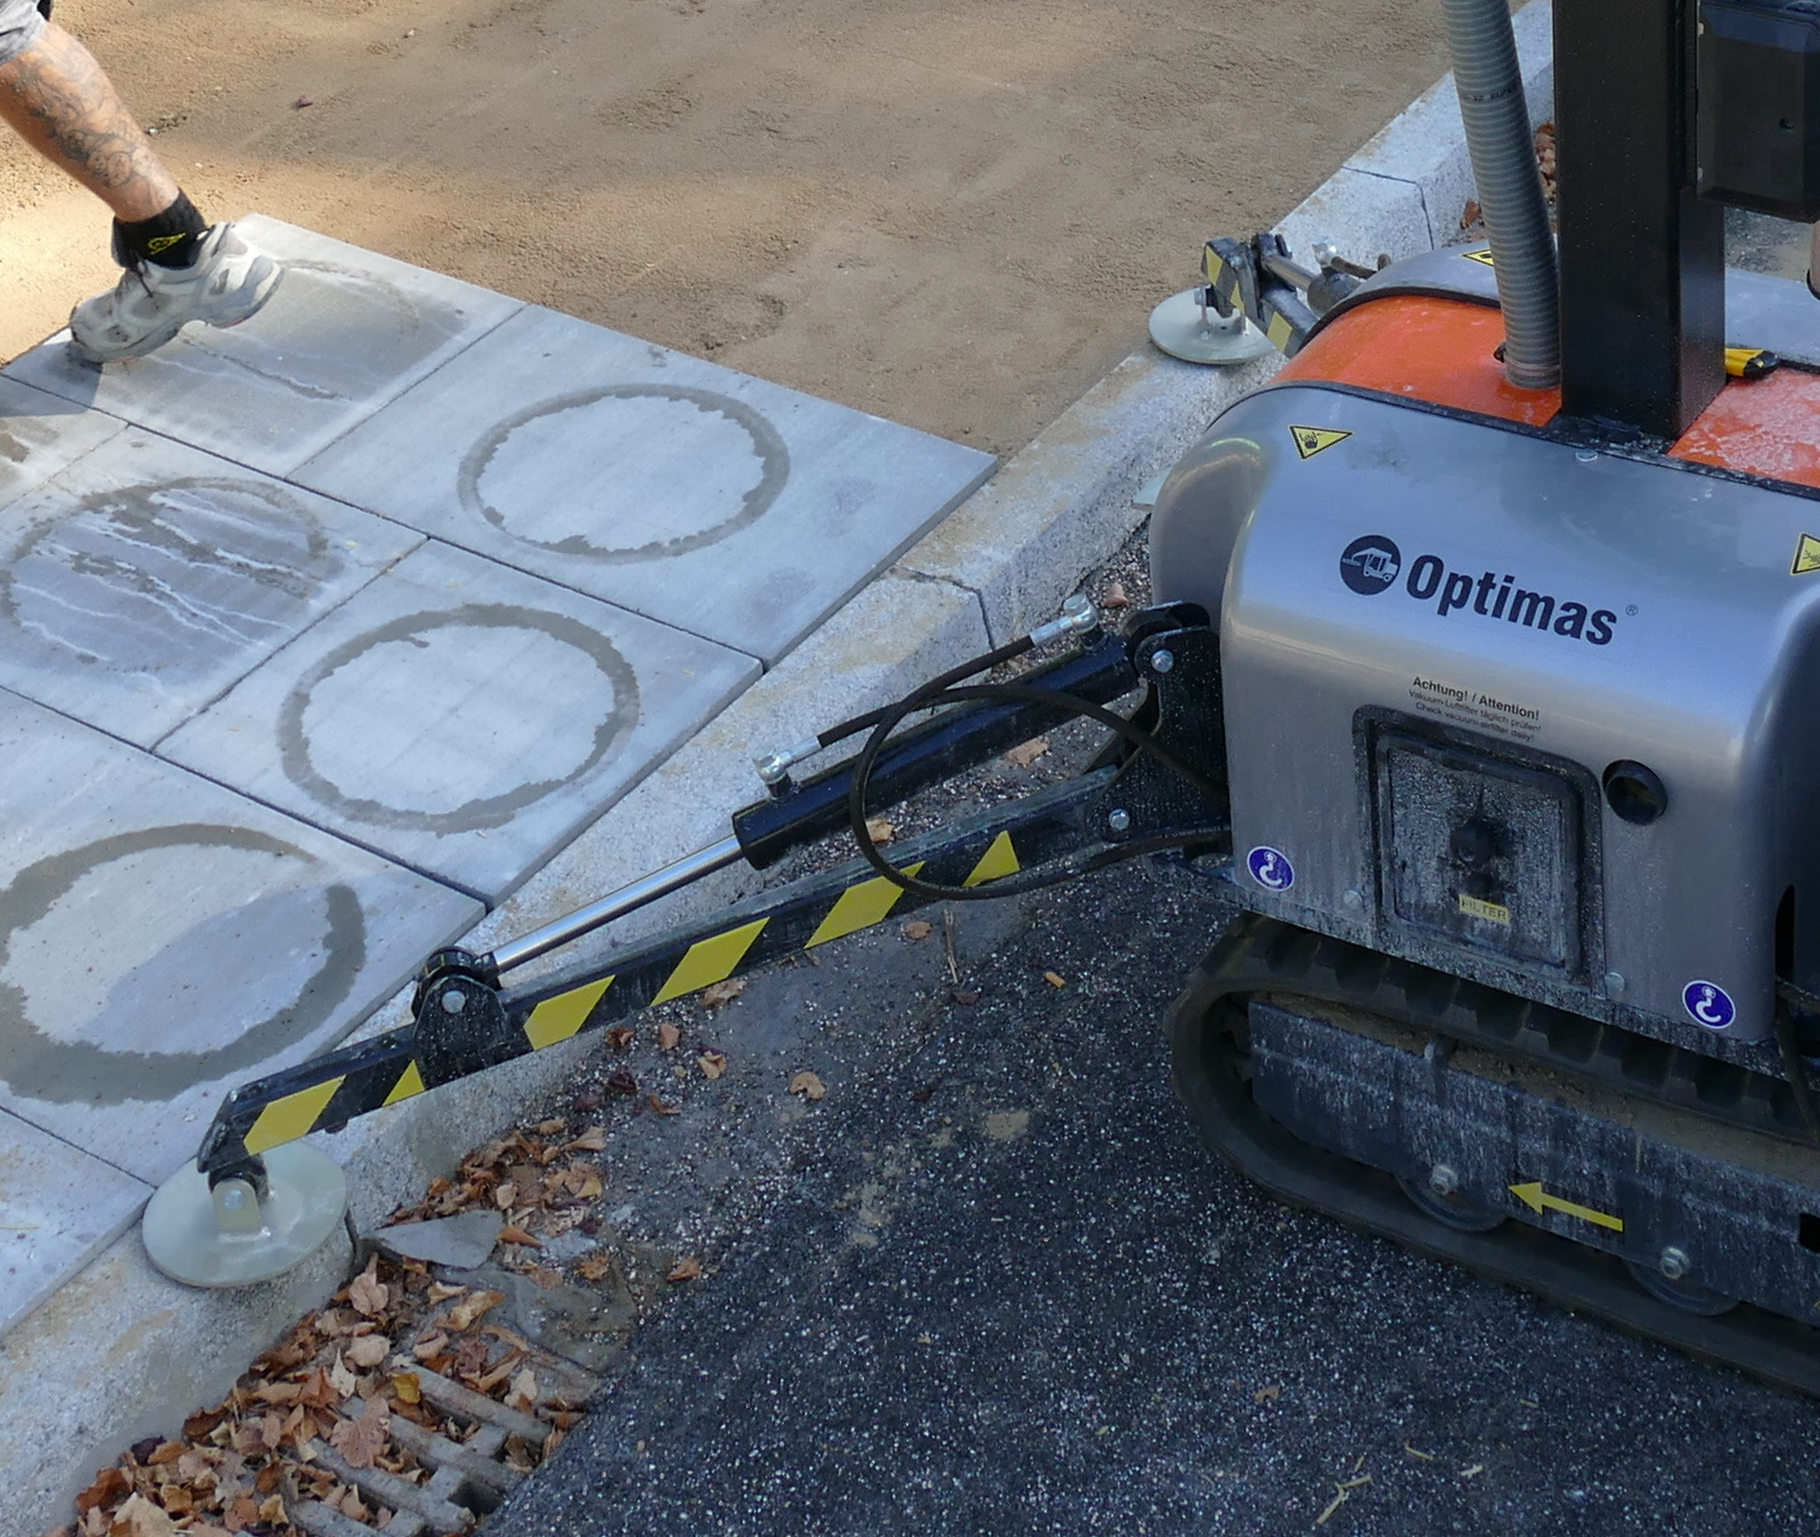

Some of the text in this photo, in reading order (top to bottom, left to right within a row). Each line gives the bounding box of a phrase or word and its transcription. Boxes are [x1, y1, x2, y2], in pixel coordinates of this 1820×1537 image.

[1406, 554, 1617, 645] Optimas
[1412, 676, 1468, 702] Achtung!
[1479, 694, 1540, 721] Attention!
[1461, 899, 1507, 921] FILTER
